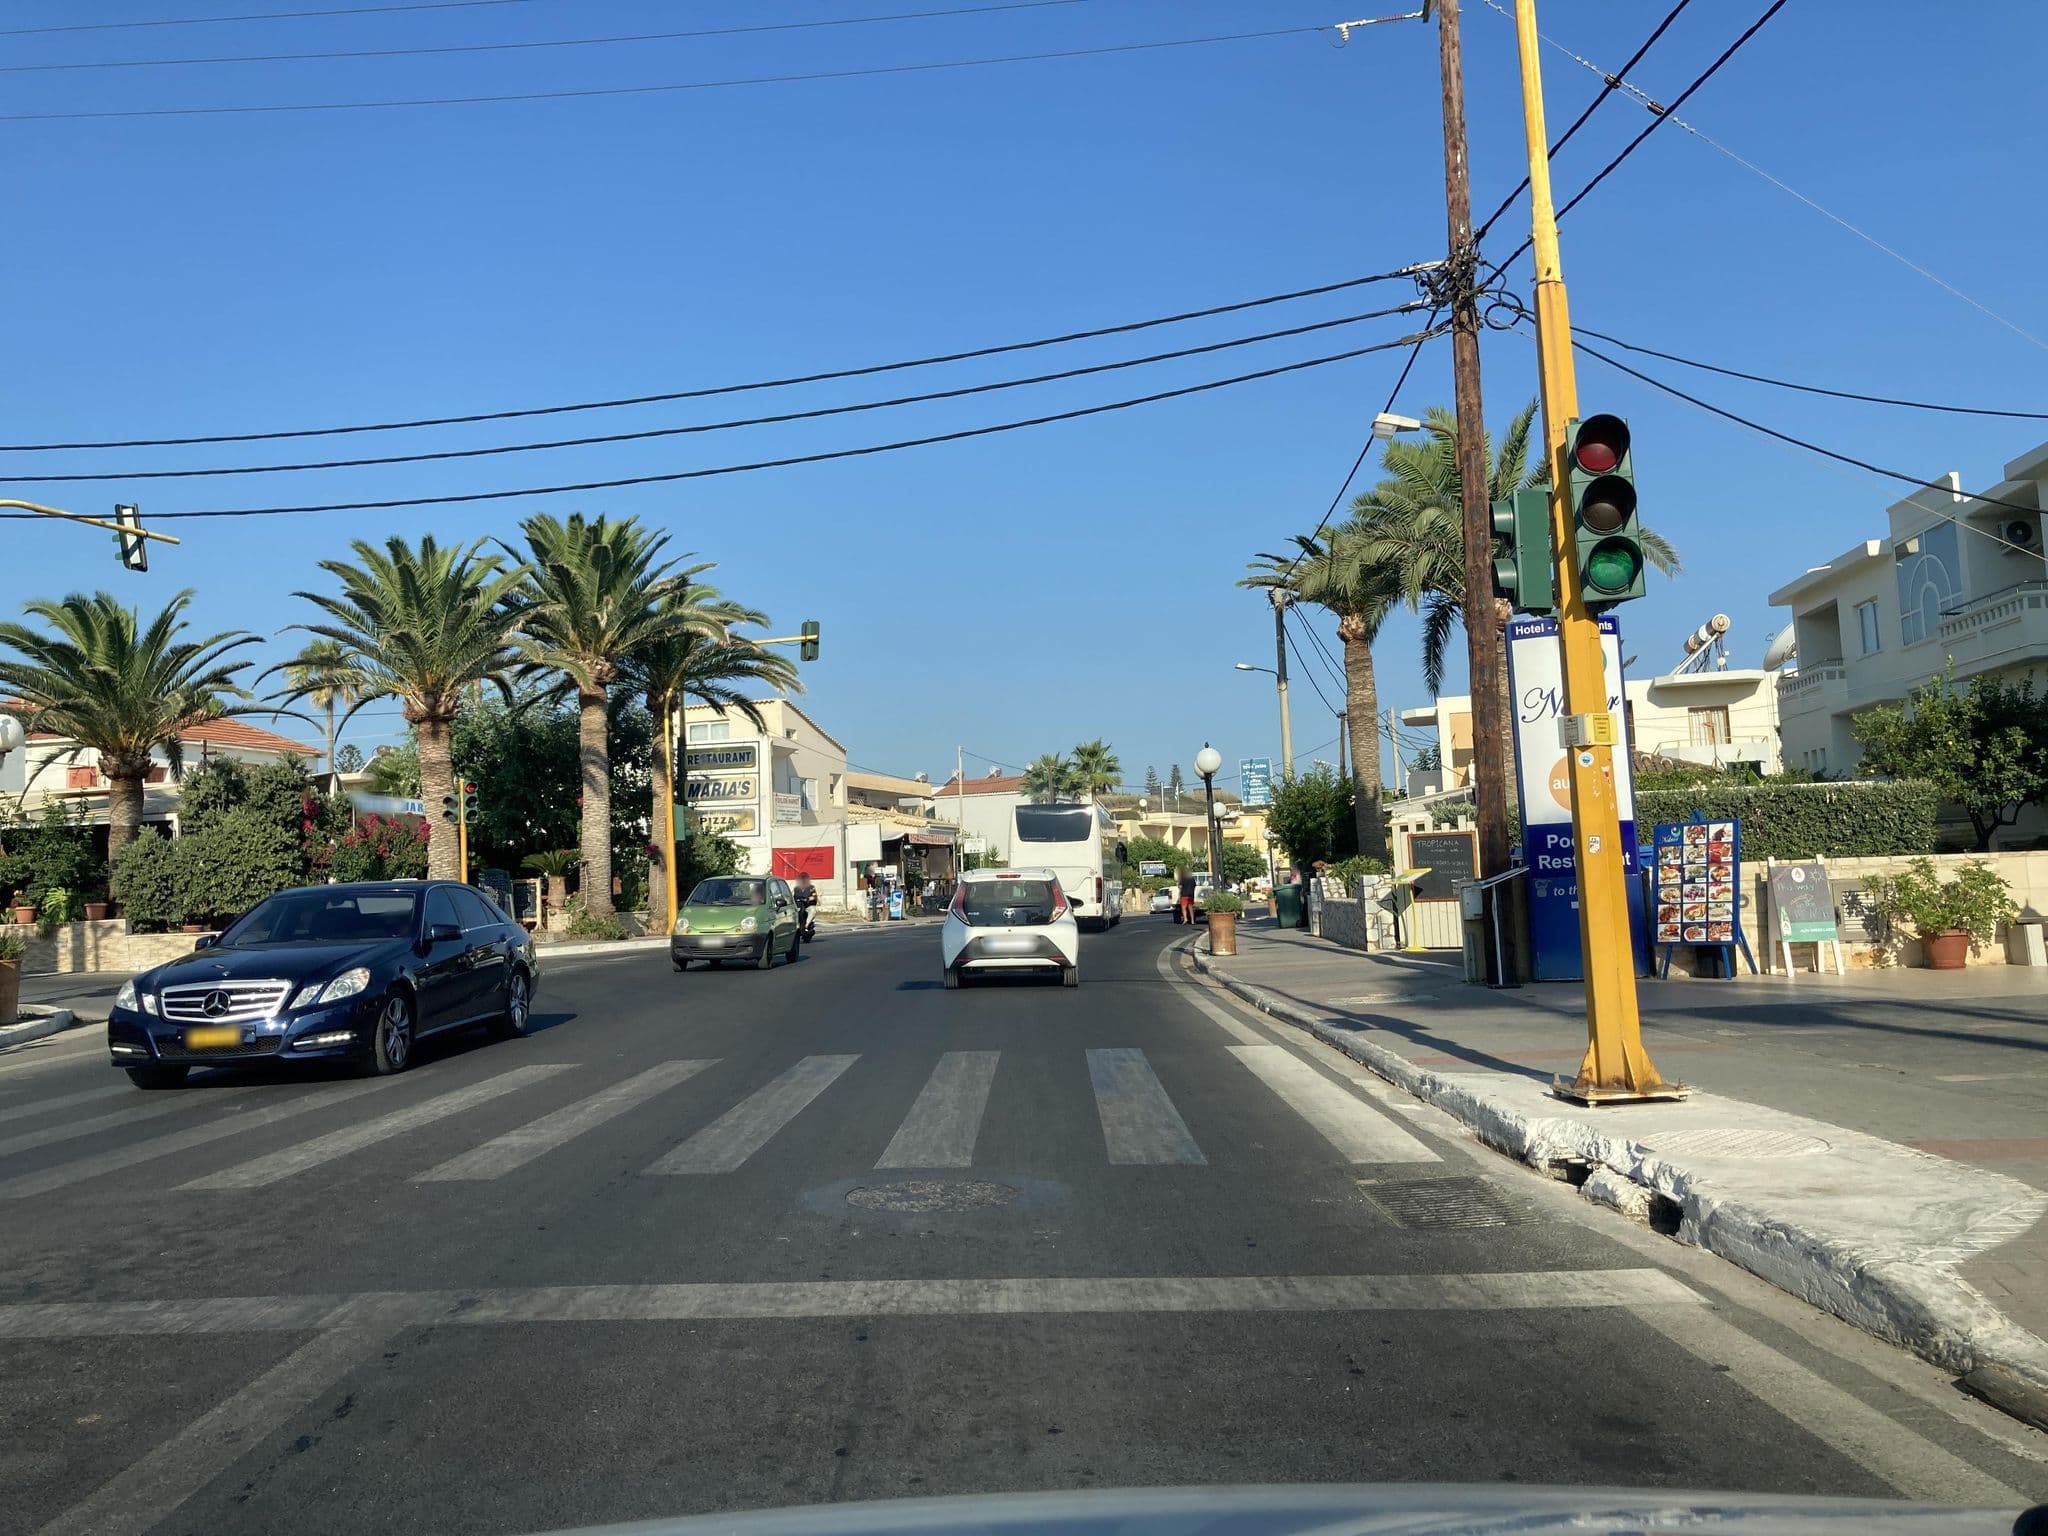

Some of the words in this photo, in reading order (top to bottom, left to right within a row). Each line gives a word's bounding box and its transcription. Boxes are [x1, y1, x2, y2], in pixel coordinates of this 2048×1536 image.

[1515, 623, 1545, 635] Hotel
[687, 751, 752, 765] RESTAURANT
[687, 781, 751, 797] MARIA'S
[1552, 779, 1570, 790] au
[699, 816, 736, 825] PIZZA
[1416, 839, 1460, 848] TROPICANA
[1546, 834, 1575, 849] Po
[1553, 887, 1565, 896] to
